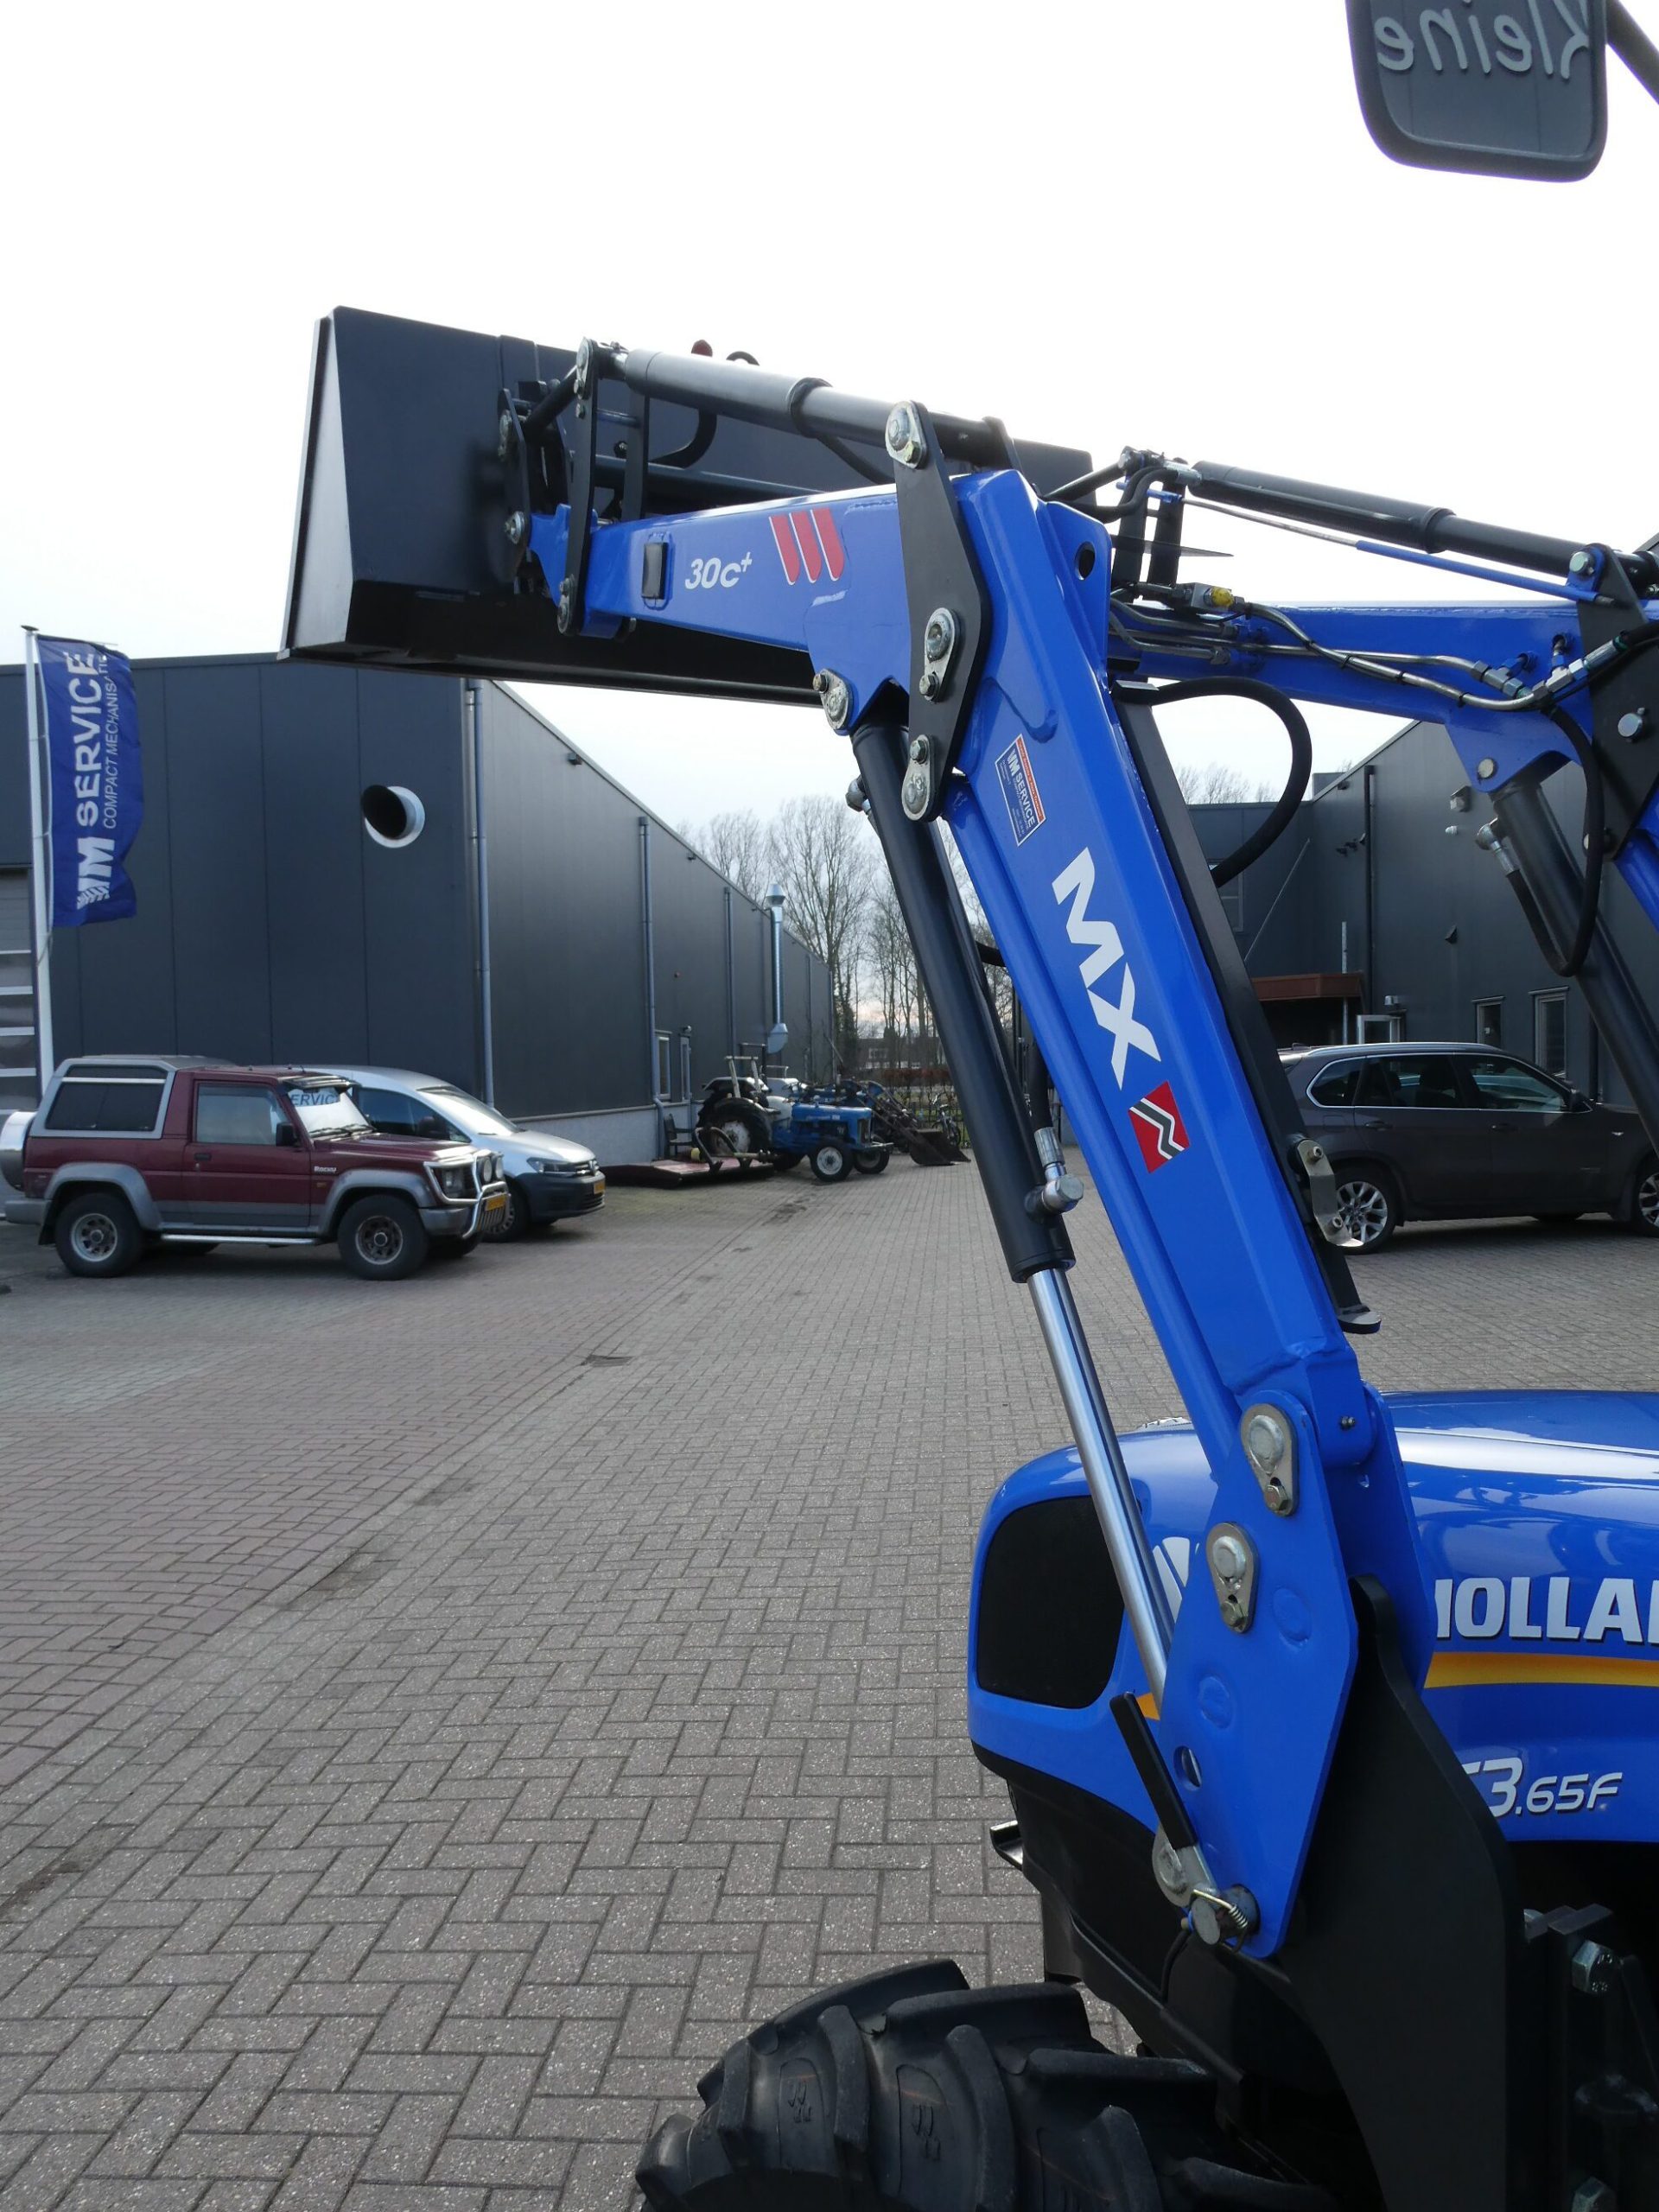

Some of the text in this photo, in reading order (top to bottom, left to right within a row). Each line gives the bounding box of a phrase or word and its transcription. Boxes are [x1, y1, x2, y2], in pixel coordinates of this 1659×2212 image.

[63, 652, 103, 827] SERVICE
[103, 759, 119, 830] COMPACT
[1015, 772, 1035, 828] SERVICE
[1052, 847, 1161, 1091] MX
[1434, 1577, 1659, 1644] OLLA
